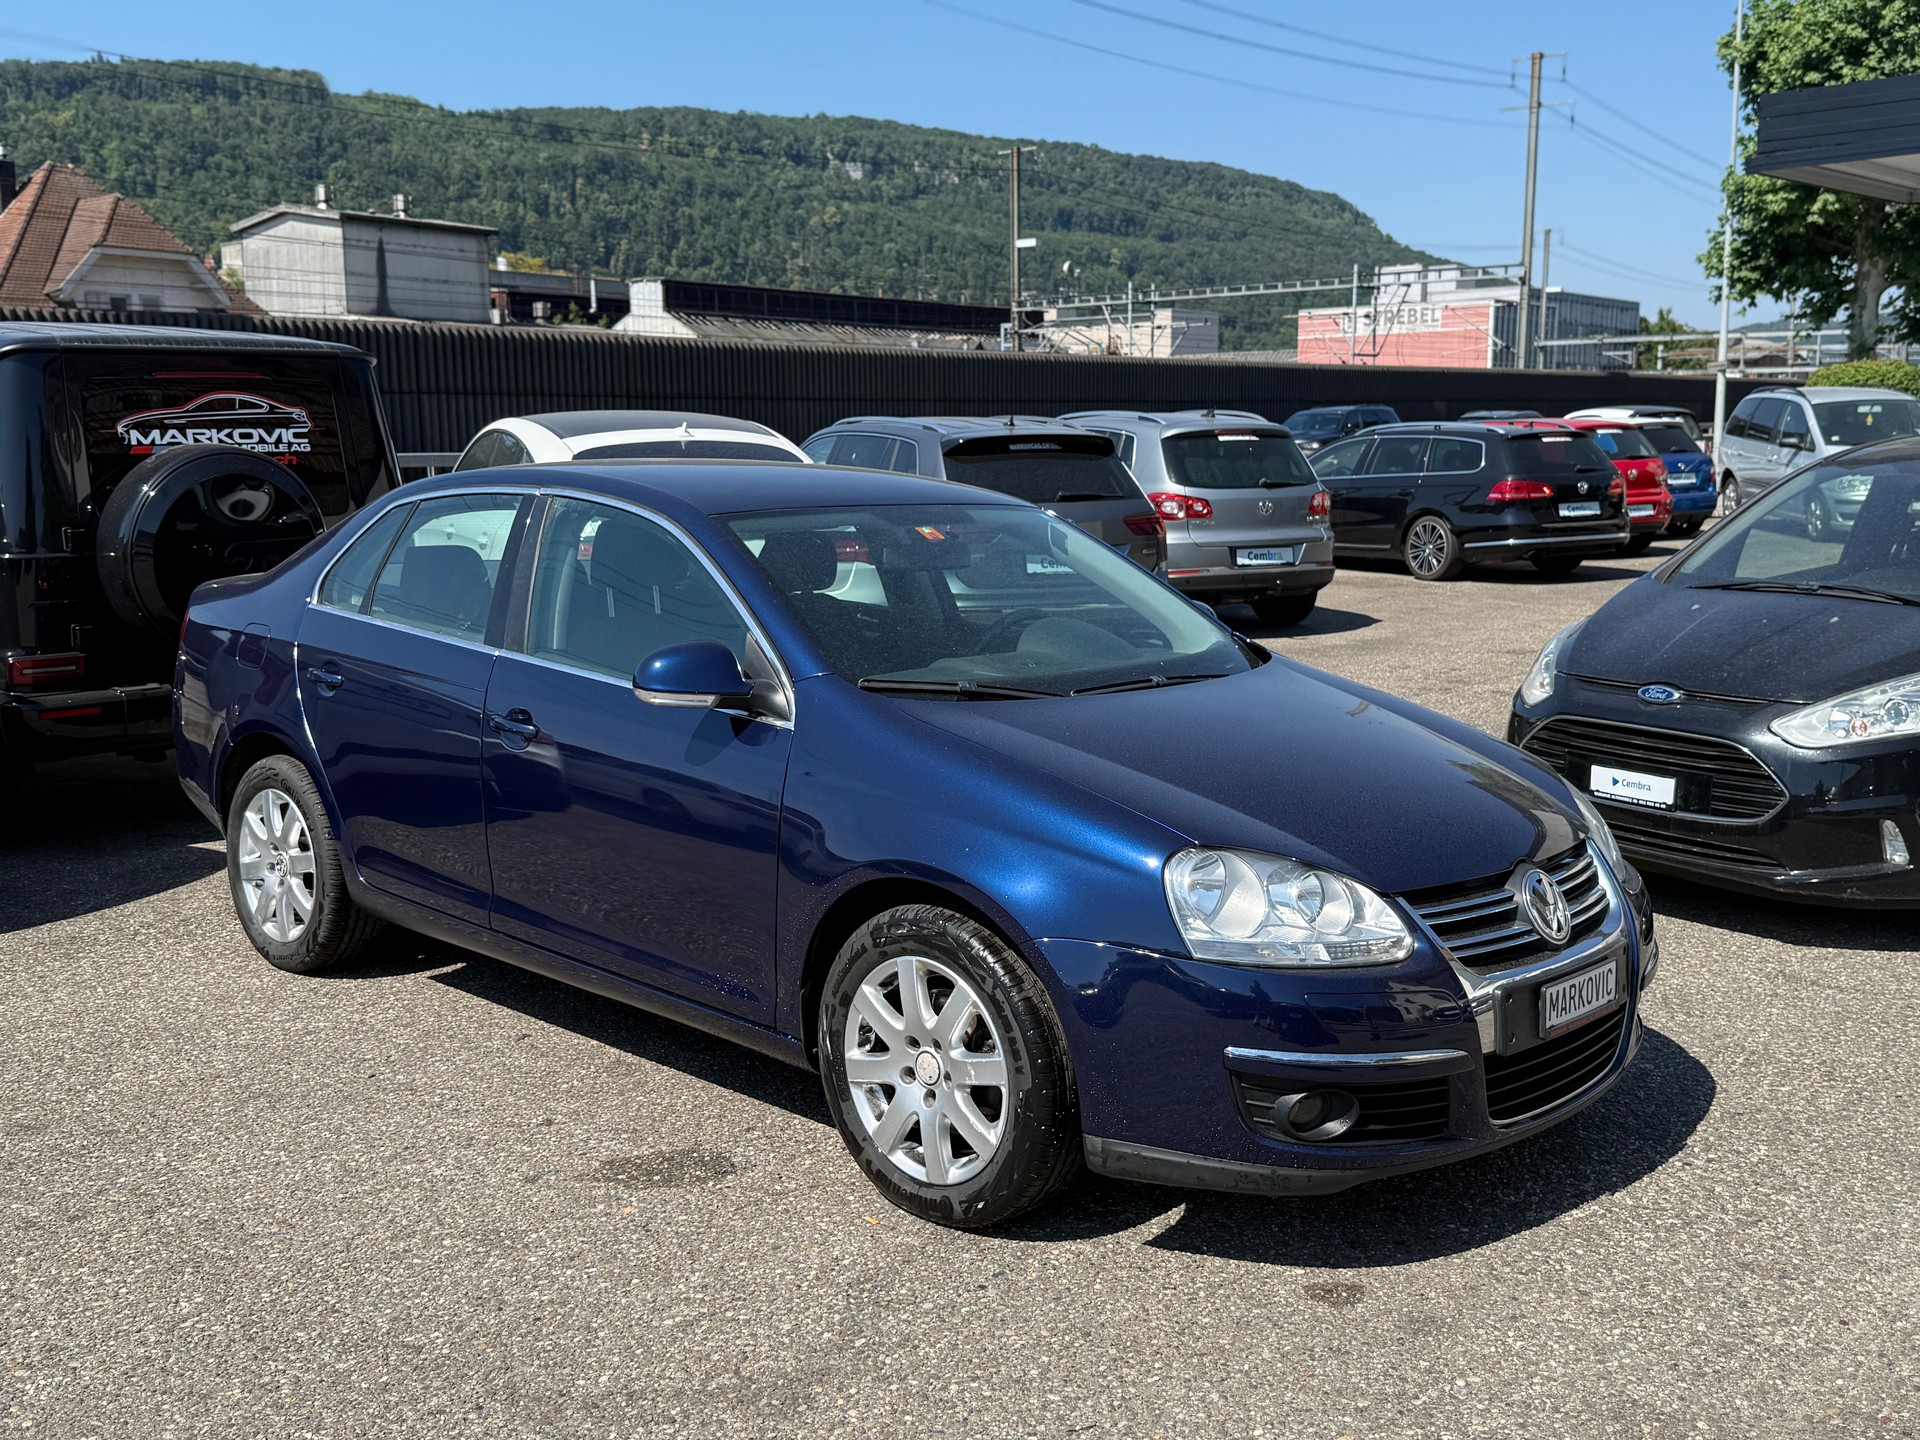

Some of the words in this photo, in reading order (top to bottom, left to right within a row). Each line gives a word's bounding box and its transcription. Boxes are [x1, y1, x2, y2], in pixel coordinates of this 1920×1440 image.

[130, 428, 309, 445] MARKOVIC
[291, 443, 312, 452] AG
[1247, 550, 1284, 561] Cembra
[1645, 688, 1669, 699] Ford
[1621, 778, 1652, 792] Cembra
[1548, 967, 1613, 1022] MARKOVIC
